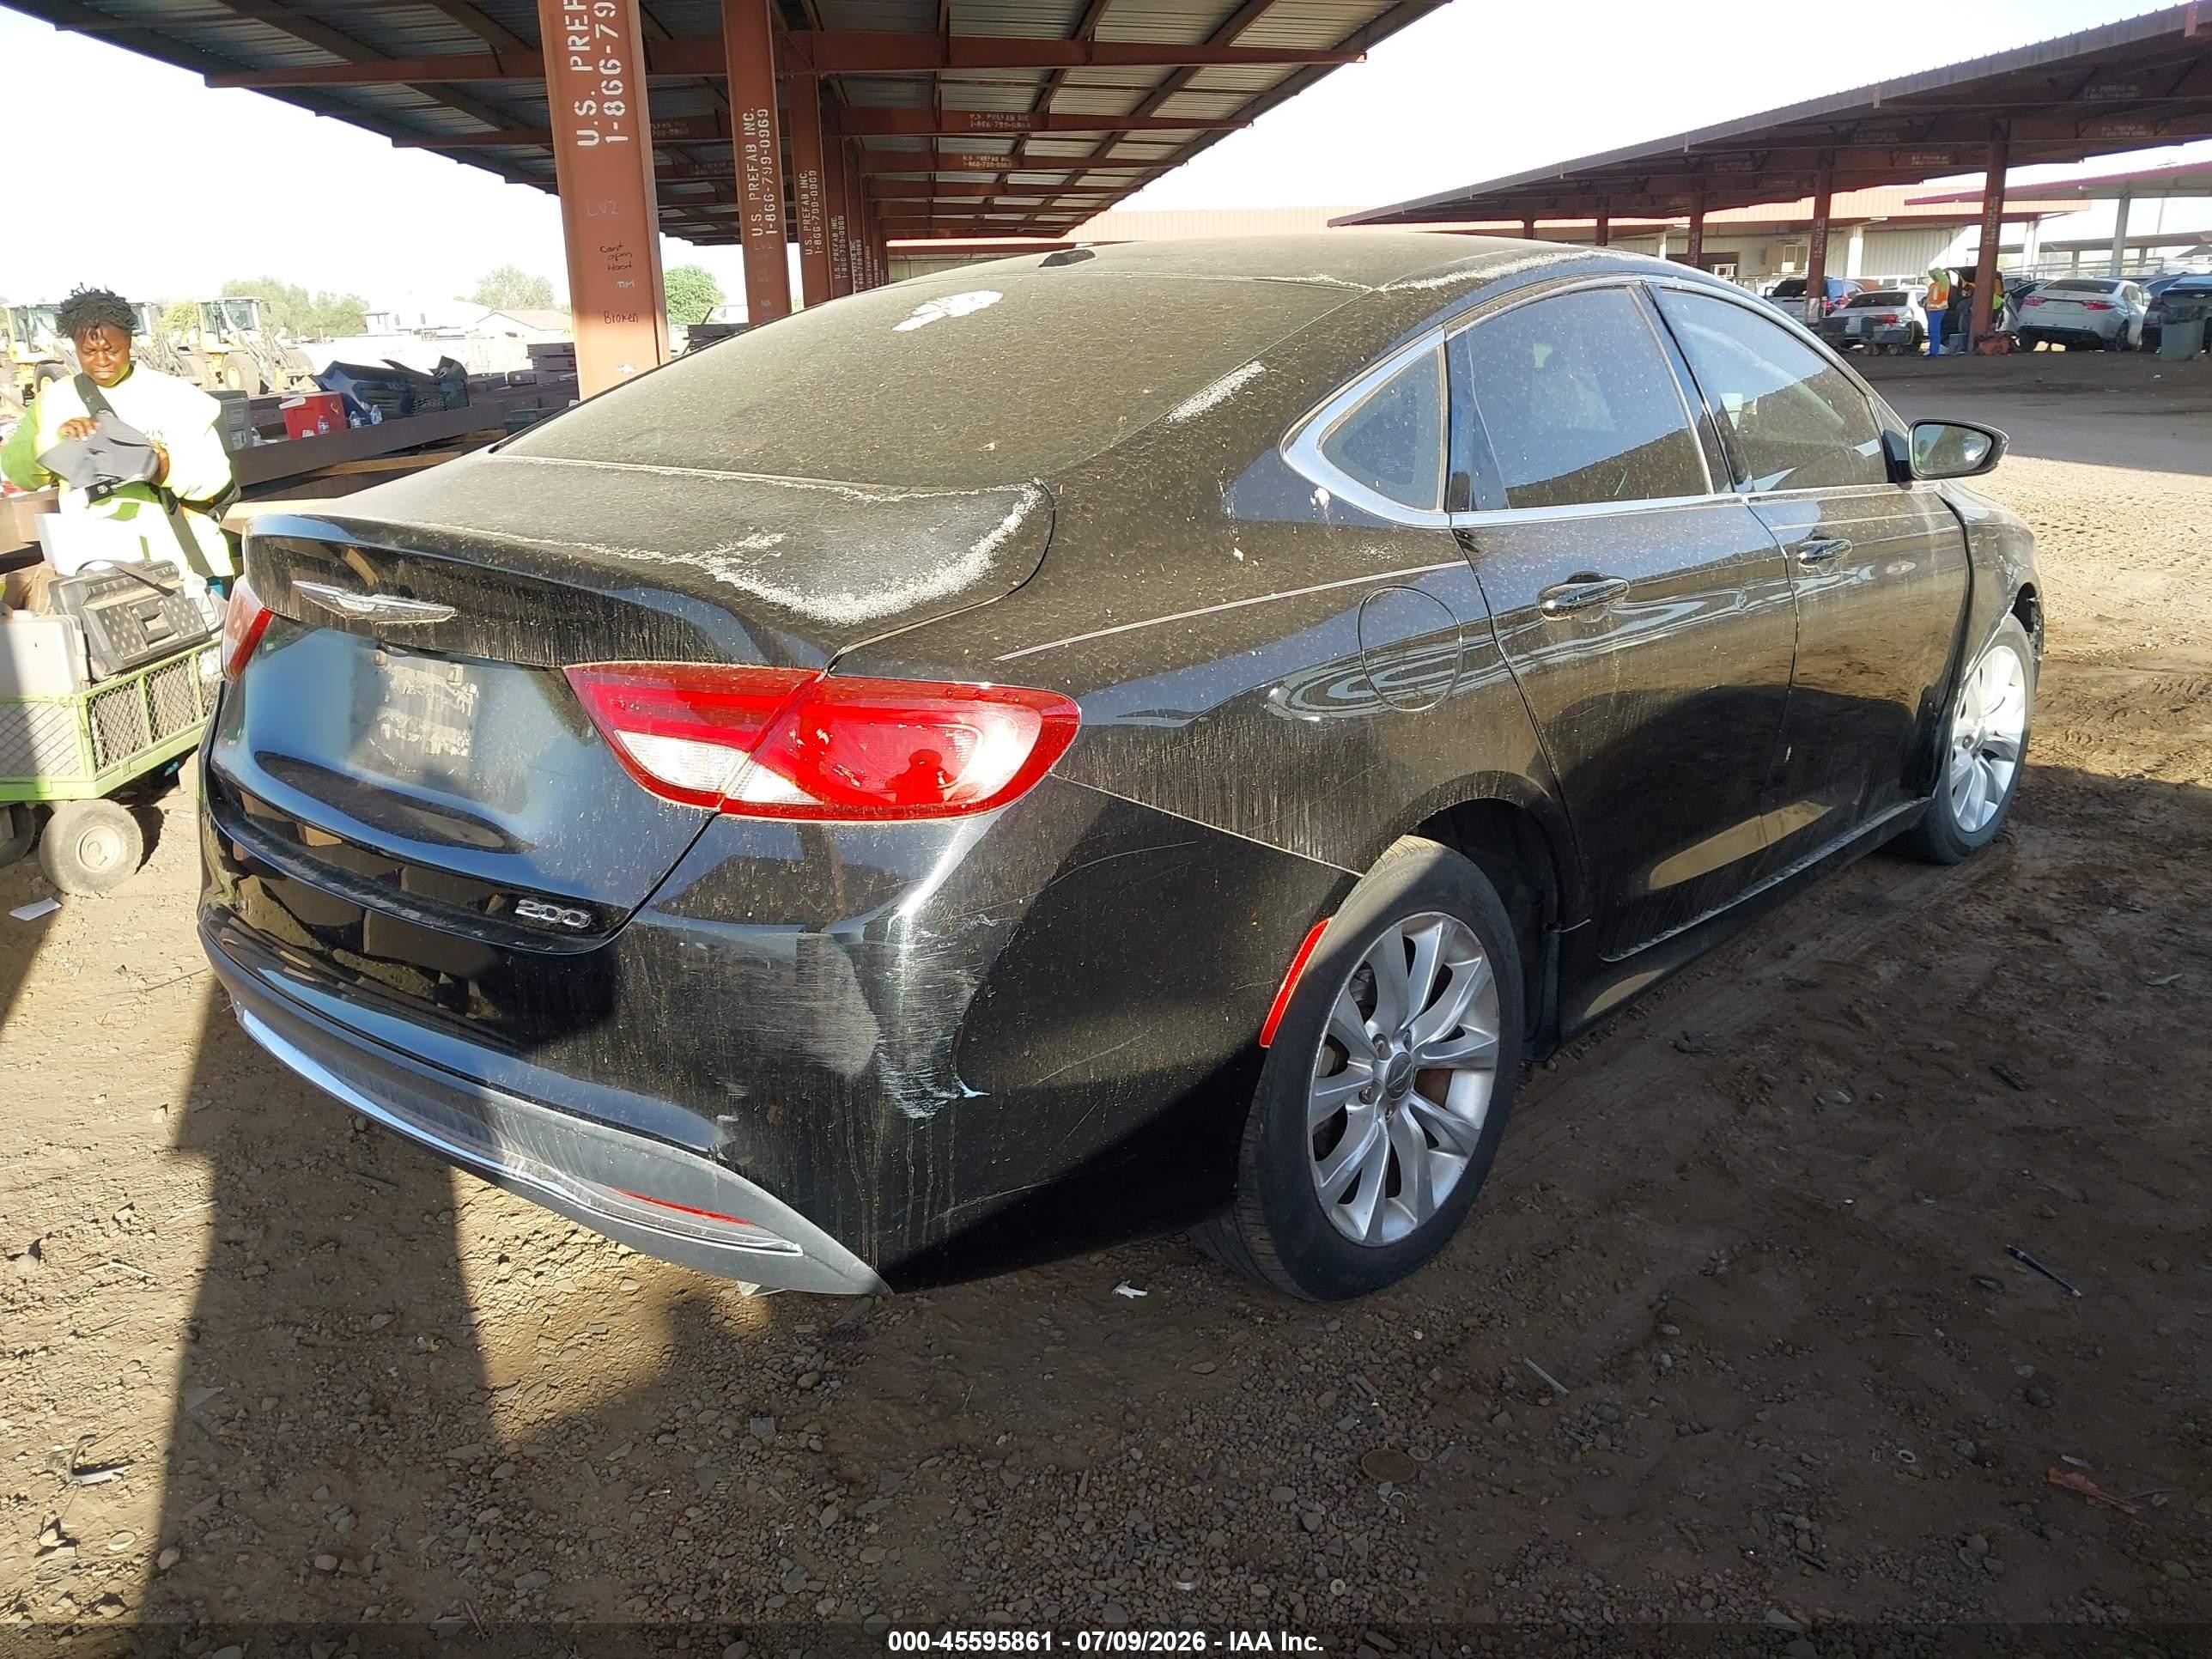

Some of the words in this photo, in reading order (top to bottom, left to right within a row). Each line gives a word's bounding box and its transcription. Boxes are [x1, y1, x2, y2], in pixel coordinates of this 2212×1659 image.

[593, 2, 629, 143] 1-866-79
[574, 90, 599, 146] U.S.
[742, 107, 756, 136] INC.
[745, 143, 761, 201] PREFAB
[757, 108, 778, 234] 1-866-799-0969
[799, 170, 809, 188] INC.
[750, 209, 763, 236] U.S.
[801, 193, 812, 231] PREFAB
[804, 236, 813, 255] U.S.
[604, 311, 639, 325] Broken
[515, 899, 591, 928] 200
